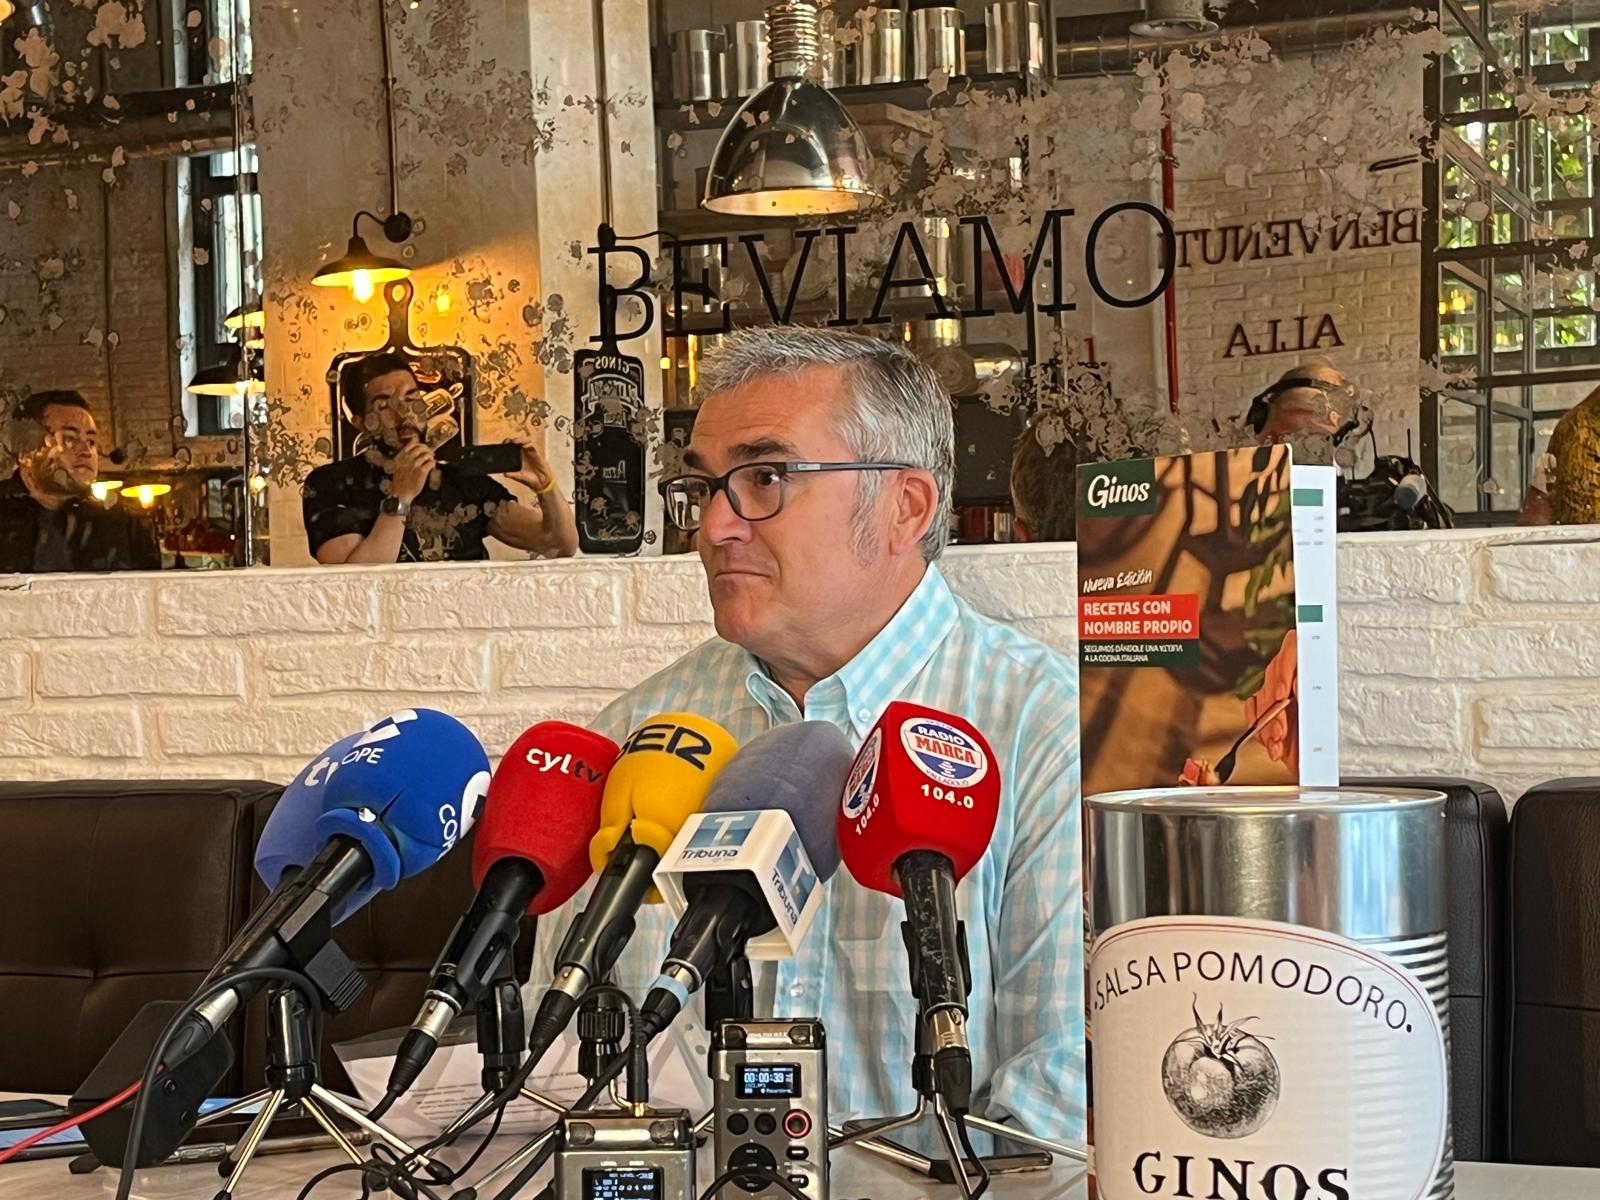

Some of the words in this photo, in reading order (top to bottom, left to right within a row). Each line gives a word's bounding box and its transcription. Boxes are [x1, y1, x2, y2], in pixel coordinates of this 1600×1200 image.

[587, 201, 1176, 343] BEVIAMO
[1087, 474, 1151, 509] Ginos
[1084, 602, 1141, 616] RECETAS
[1142, 600, 1171, 615] CON
[1084, 621, 1141, 635] NOMBRE
[1143, 619, 1192, 634] PROPIO
[917, 725, 965, 746] RADIO
[915, 735, 977, 765] MARCA
[920, 783, 975, 809] 104.0
[681, 848, 739, 860] Tribuna
[772, 867, 799, 926] Tribuna
[1132, 1150, 1350, 1200] GINOS
